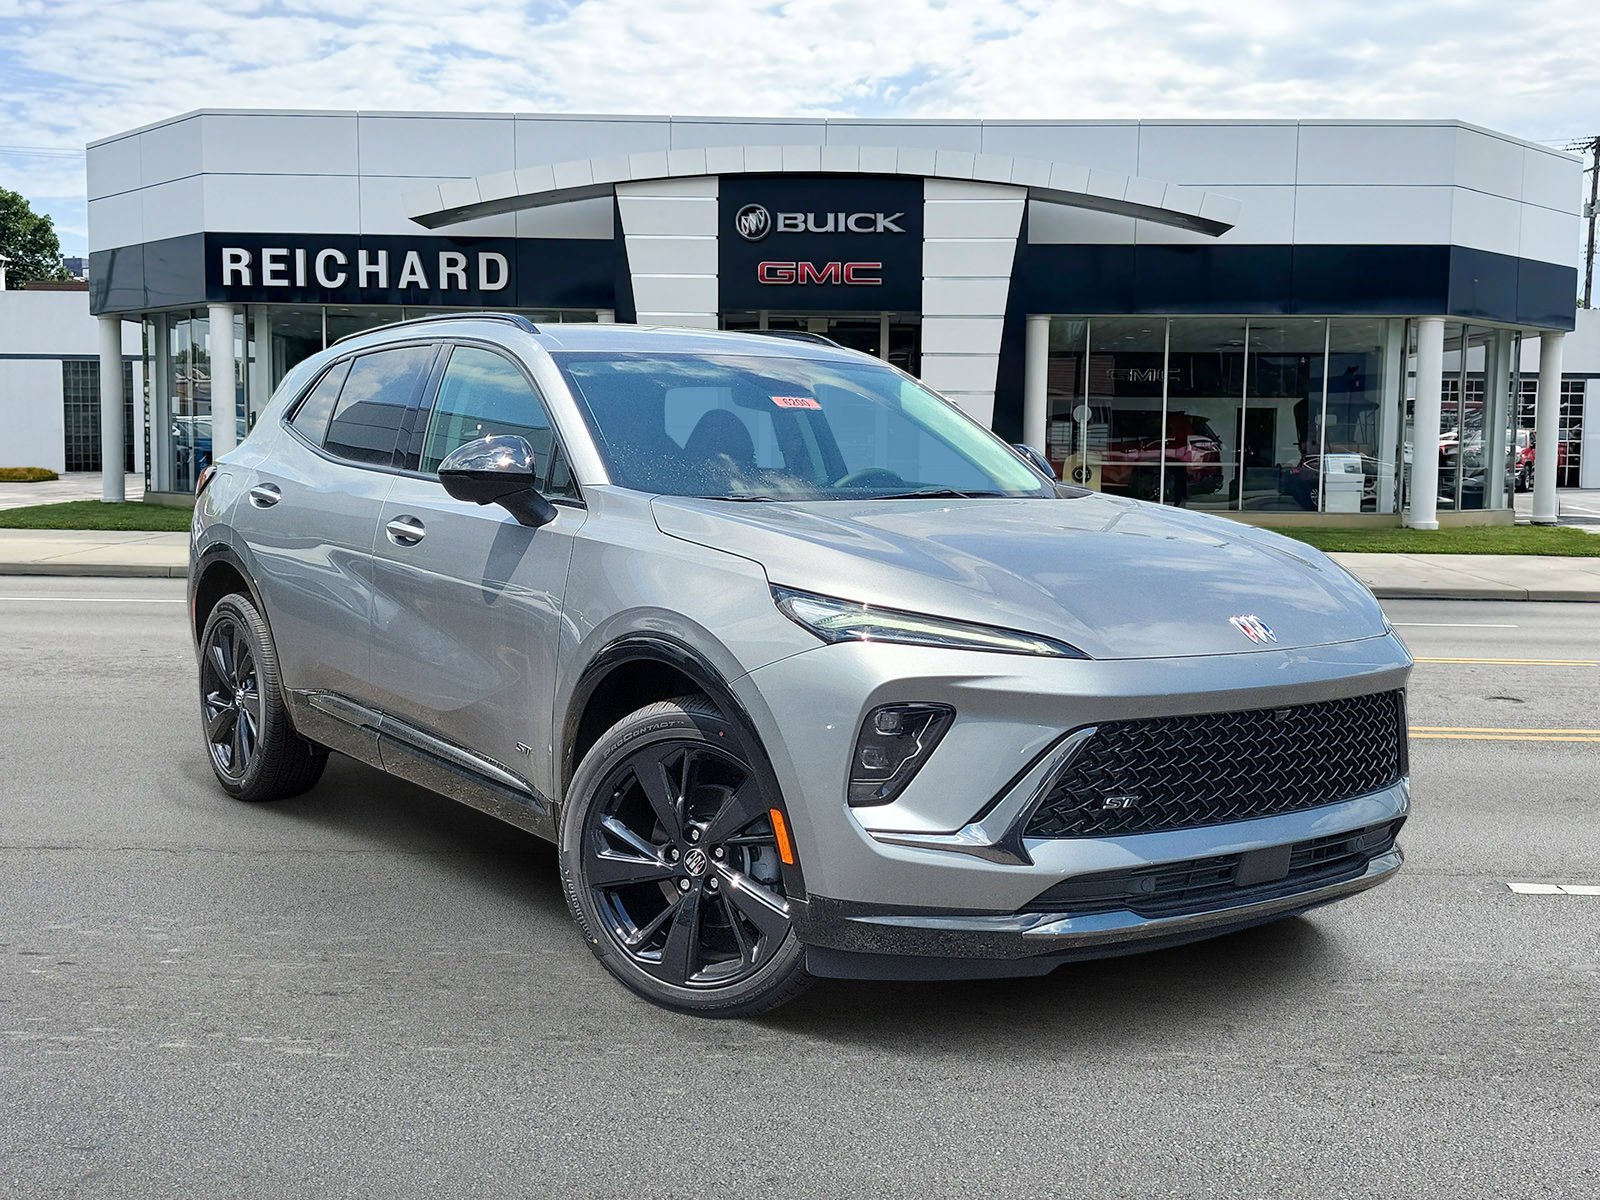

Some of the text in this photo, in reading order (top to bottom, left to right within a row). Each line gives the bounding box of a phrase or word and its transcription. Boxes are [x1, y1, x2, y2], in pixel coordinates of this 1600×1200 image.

[776, 212, 906, 233] BUICK
[221, 247, 510, 291] REICHARD
[757, 261, 882, 285] GMC
[1106, 368, 1181, 382] GMC
[782, 398, 811, 407] 6200
[515, 741, 533, 756] ST
[1102, 795, 1140, 810] ST
